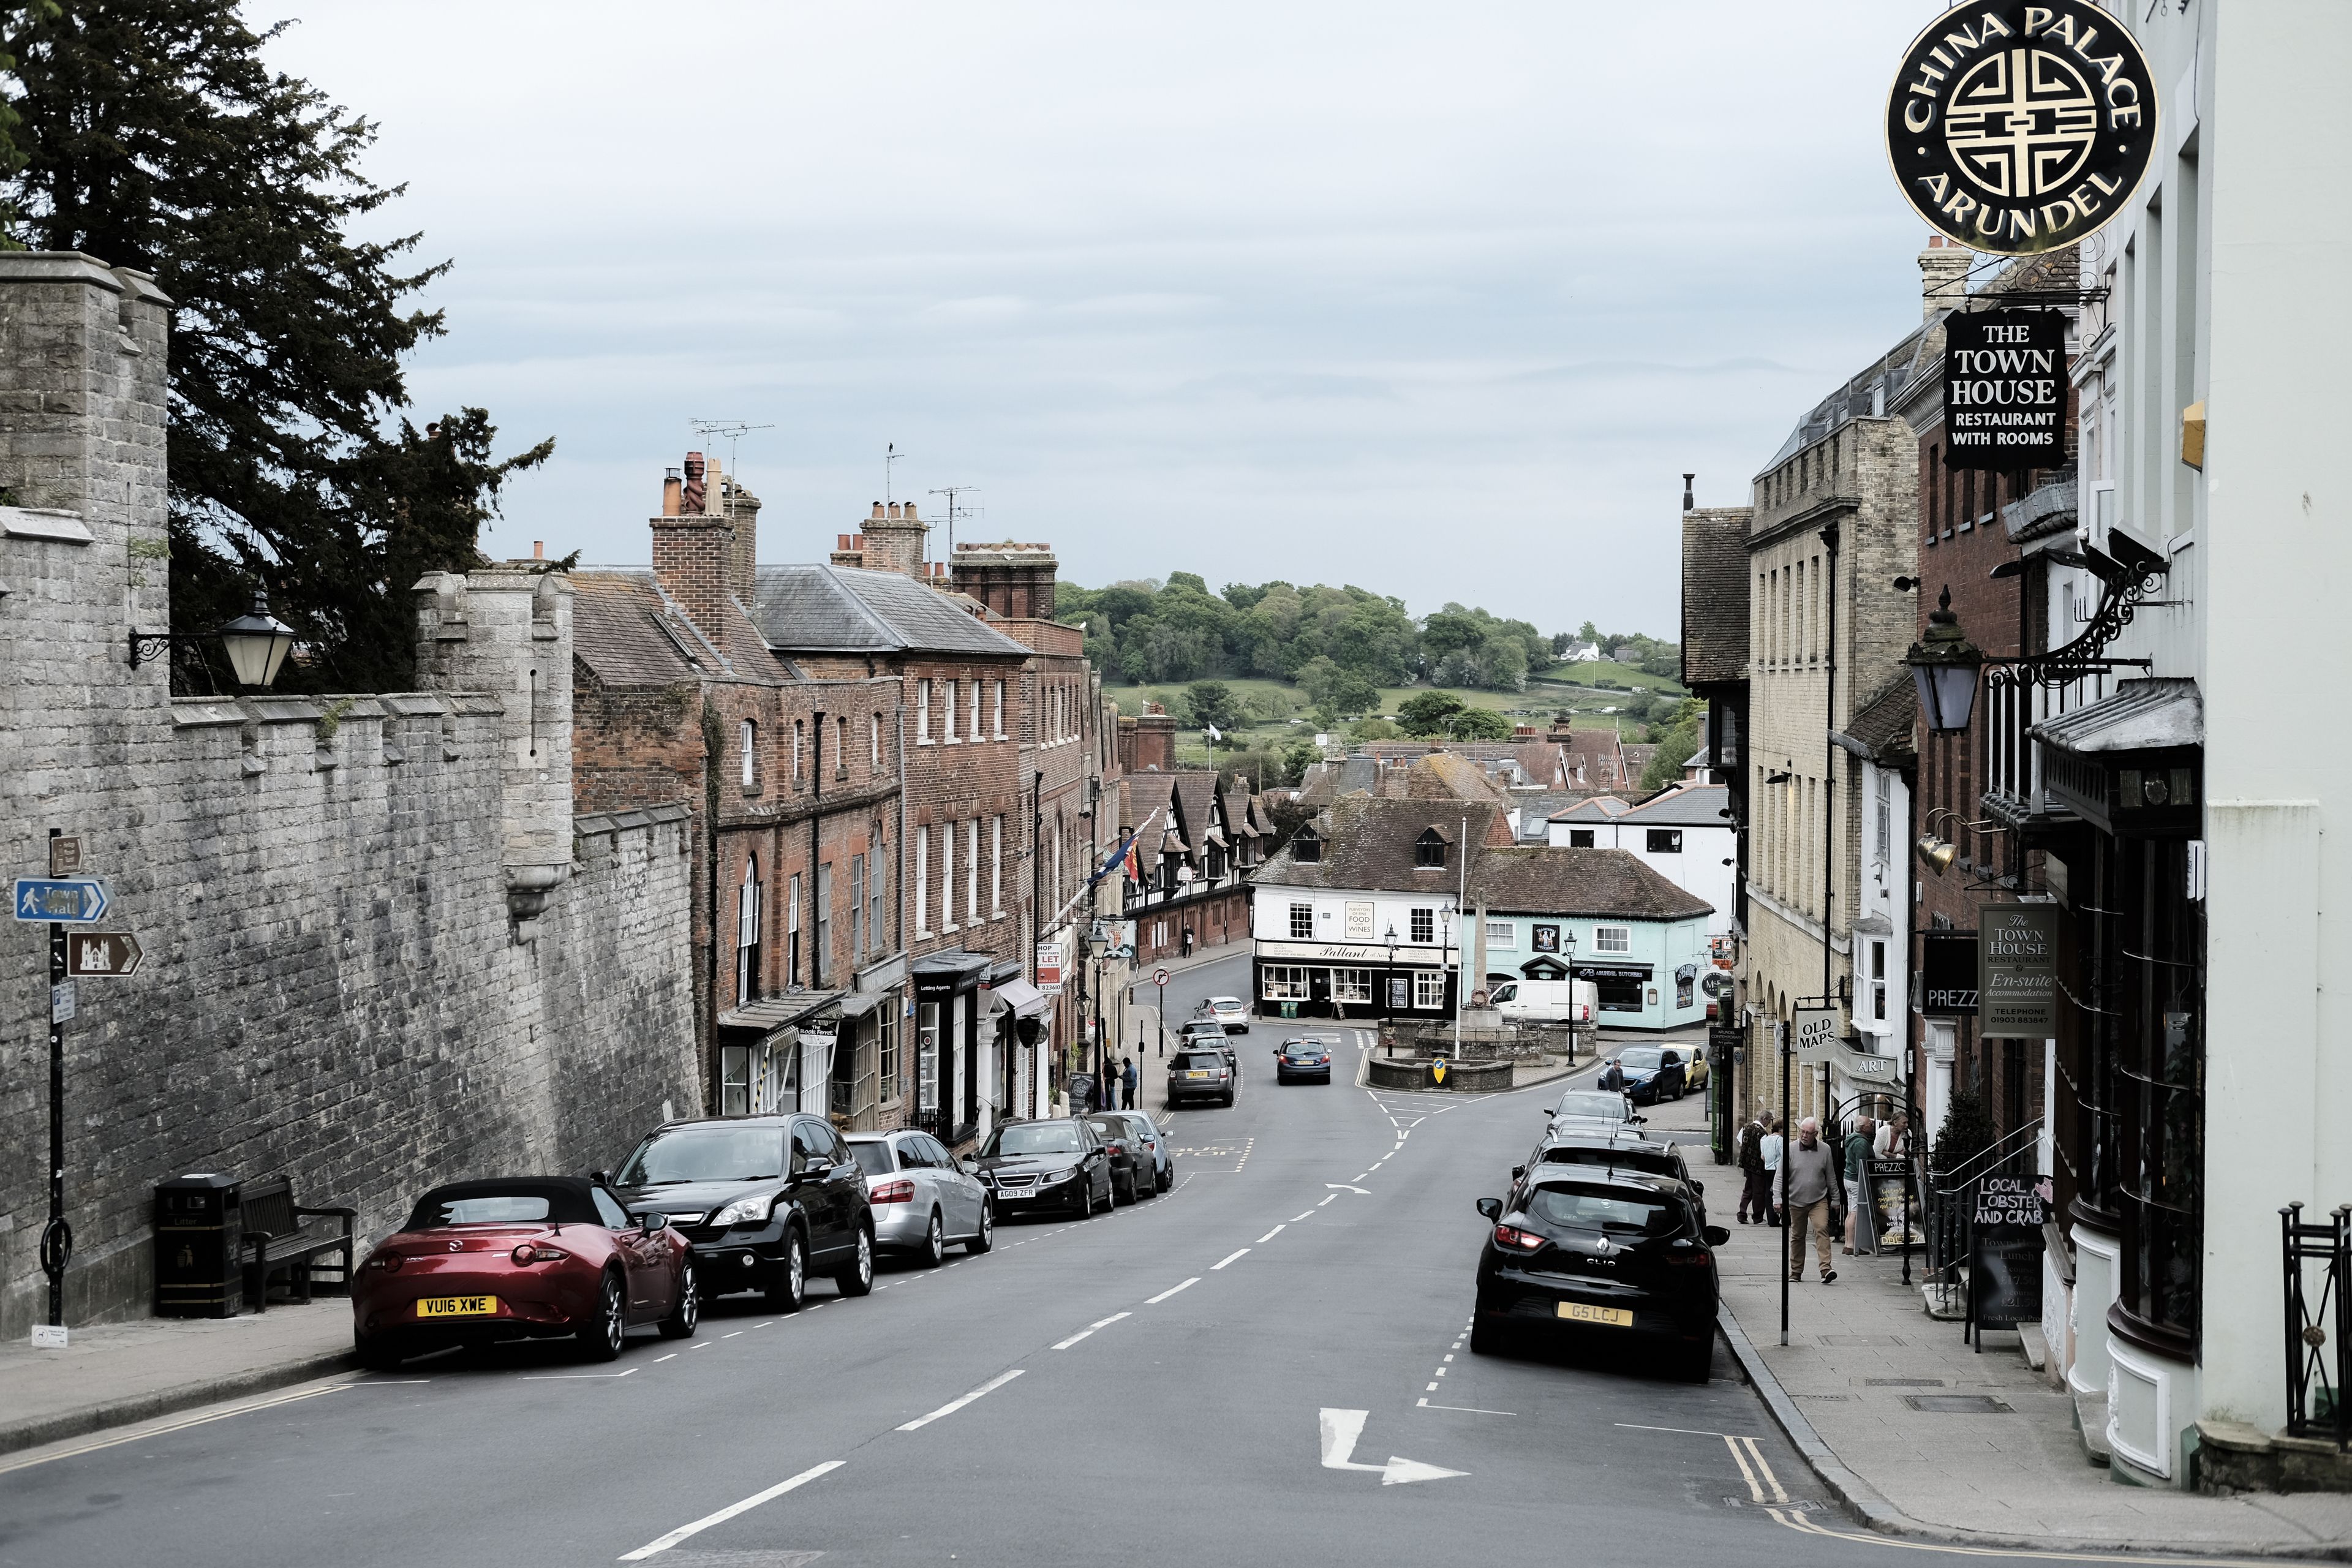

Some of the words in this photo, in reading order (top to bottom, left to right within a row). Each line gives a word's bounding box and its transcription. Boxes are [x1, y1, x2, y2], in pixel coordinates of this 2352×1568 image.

[1904, 12, 2010, 133] CHINA
[2025, 7, 2141, 129] PALACE
[1918, 172, 2122, 239] ARUNDEL
[1983, 325, 2030, 343] THE
[1954, 349, 2055, 374] TOWN
[1951, 380, 2056, 404] HOUSE
[1956, 412, 2056, 426] RESTAURANT
[1952, 432, 1991, 445] WITH
[1997, 432, 2054, 445] ROOMS
[2008, 914, 2029, 927] The
[1994, 929, 2044, 942] TOWN
[1319, 945, 1367, 958] Pallant
[1989, 941, 2048, 956] HOUSE
[1990, 973, 2052, 987] En-suite
[1929, 990, 1978, 1007] PREZZ
[1985, 989, 2053, 997] Accommodation
[1802, 1019, 1831, 1035] OLD
[1799, 1031, 1835, 1049] MAPS
[1857, 1060, 1887, 1072] ART
[1856, 1082, 1890, 1092] PRINTS
[1980, 1178, 2027, 1194] LOCAL
[1977, 1194, 2043, 1213] LOBSTER
[1974, 1210, 2003, 1224] AND
[2005, 1210, 2043, 1226] CRAB
[1982, 1238, 2011, 1246] Town
[2016, 1238, 2046, 1248] Hous
[1586, 1257, 1616, 1267] CLIO
[2000, 1250, 2034, 1261] Lunch
[426, 1298, 456, 1314] VU16
[460, 1297, 487, 1313] XWE
[1572, 1305, 1589, 1318] G5
[1593, 1306, 1619, 1322] LCJ
